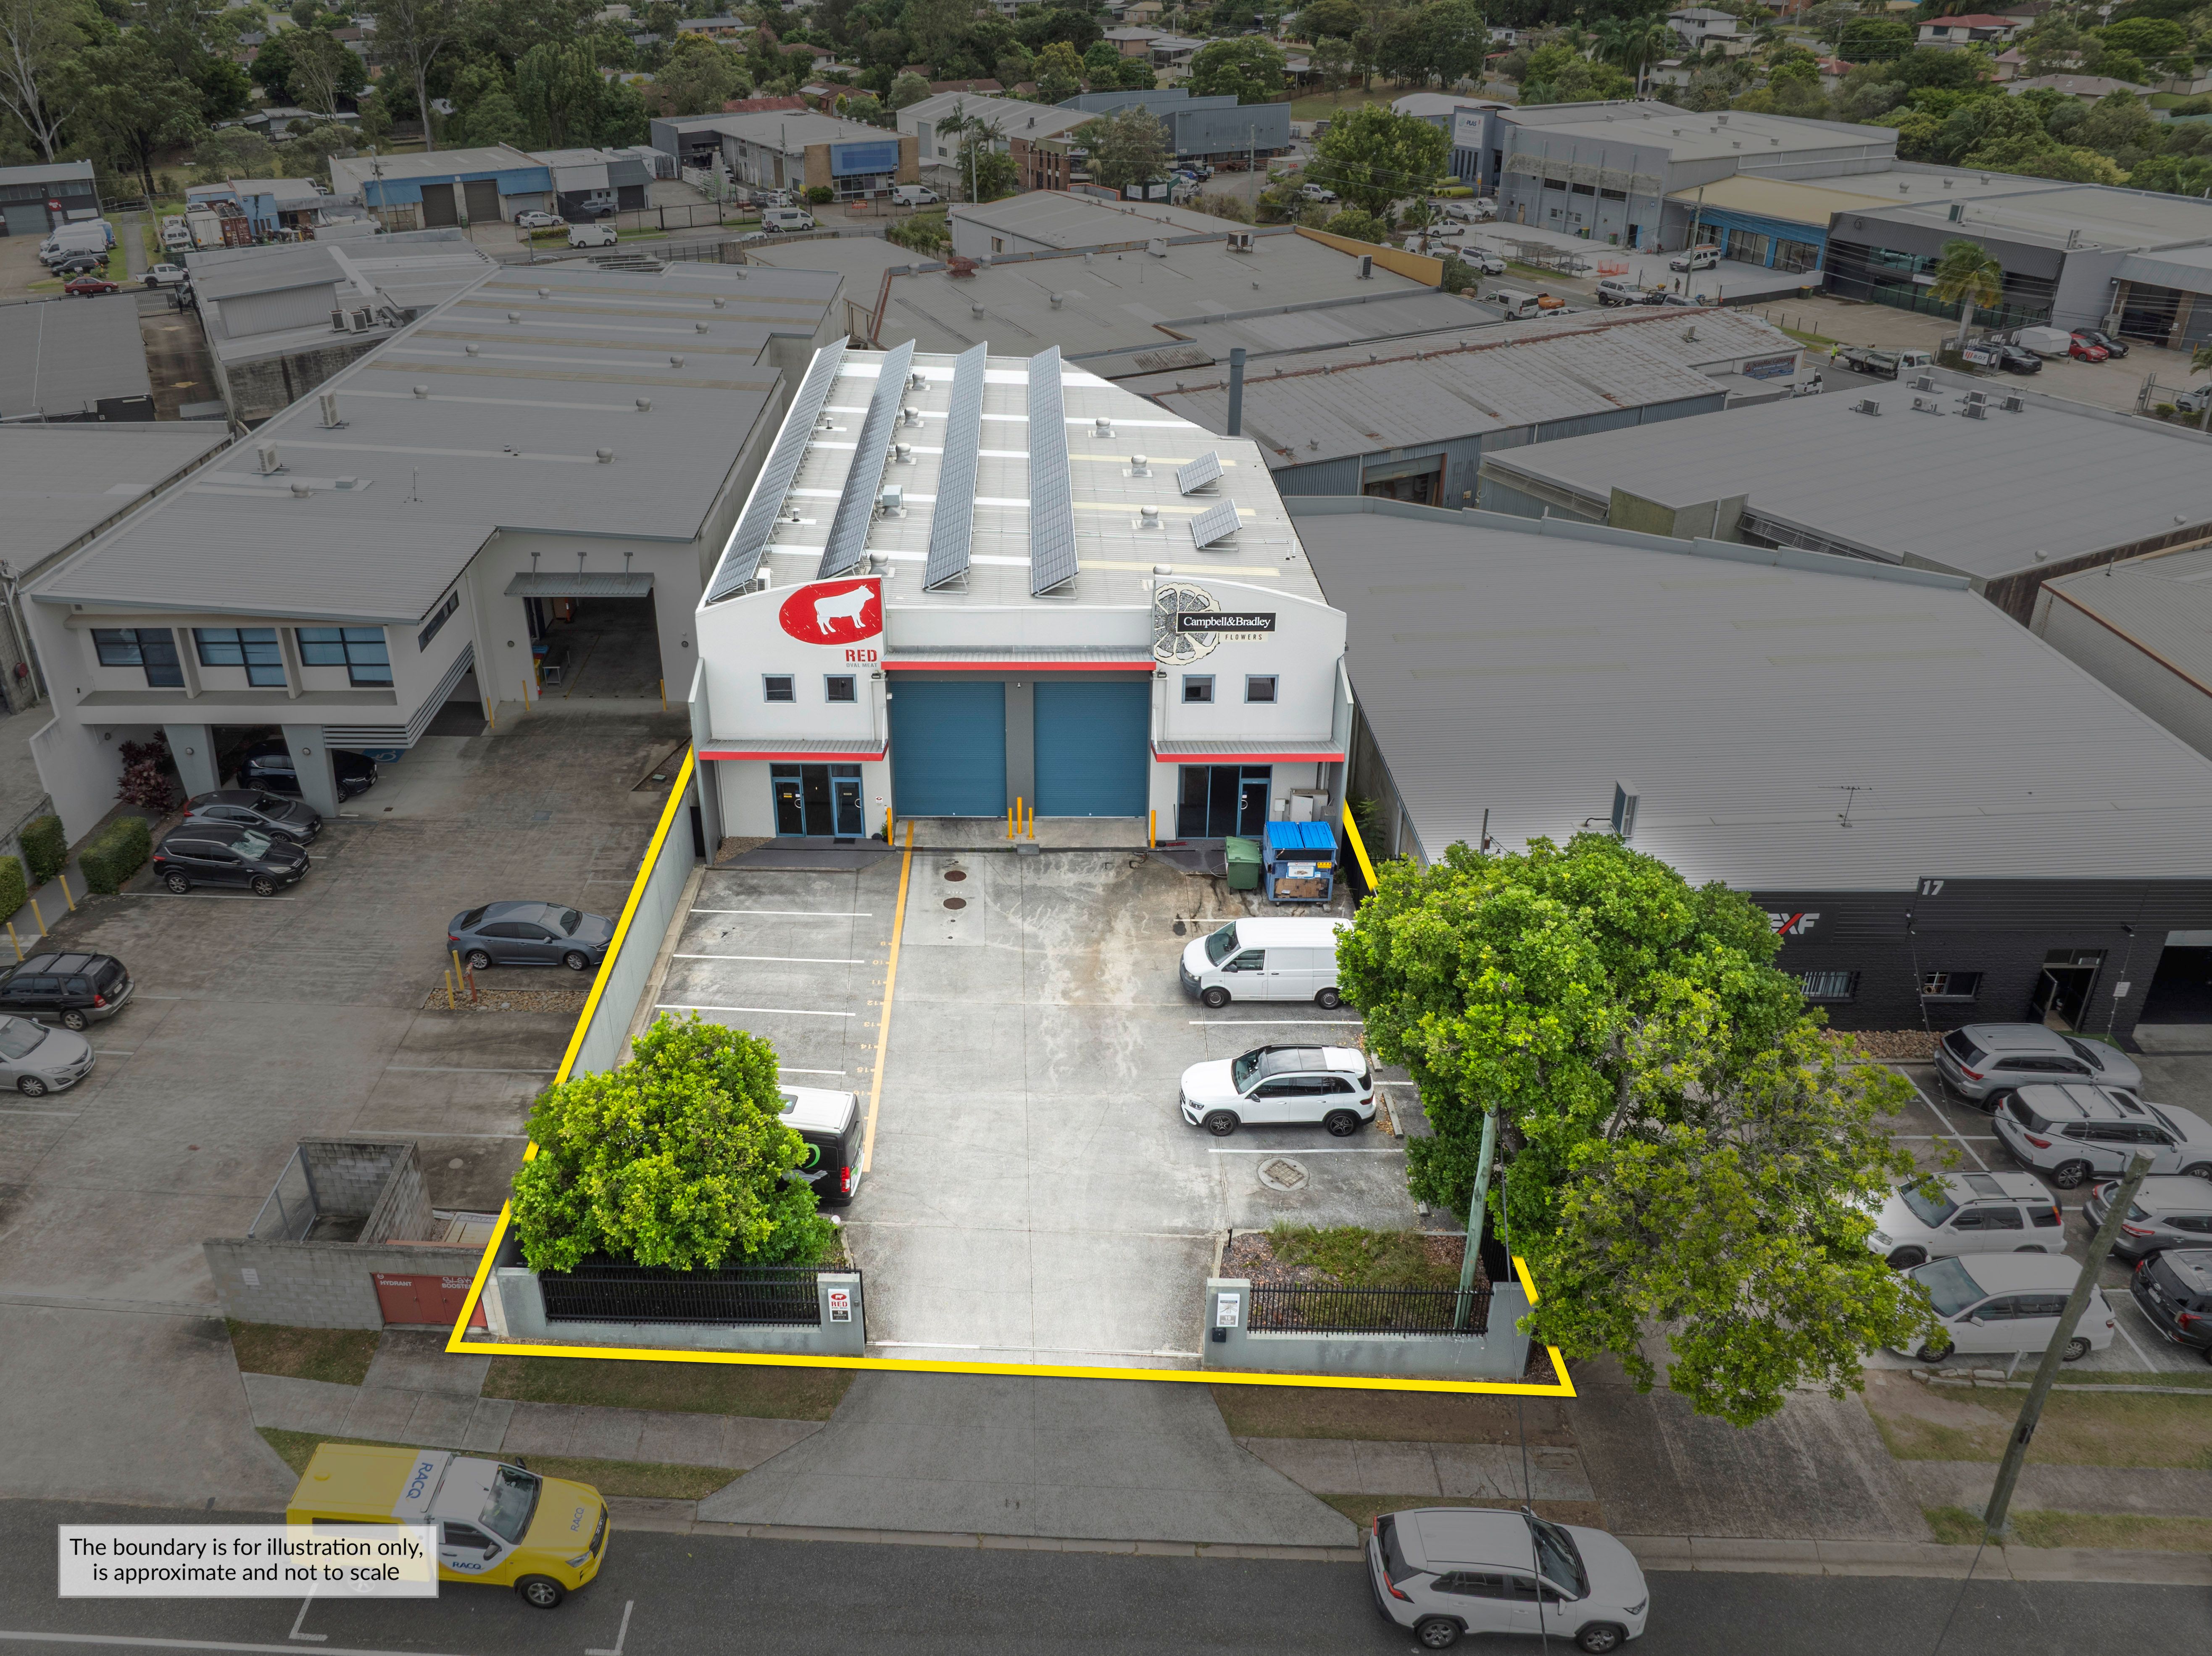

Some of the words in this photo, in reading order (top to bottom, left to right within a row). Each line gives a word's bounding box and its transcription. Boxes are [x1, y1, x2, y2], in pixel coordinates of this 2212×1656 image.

[1183, 616, 1271, 628] Campbell&Bradley
[845, 649, 877, 662] RED
[1922, 881, 1944, 895] 17
[406, 1462, 434, 1499] RACQ
[570, 1507, 585, 1532] RACQ
[452, 1561, 482, 1570] RACQ
